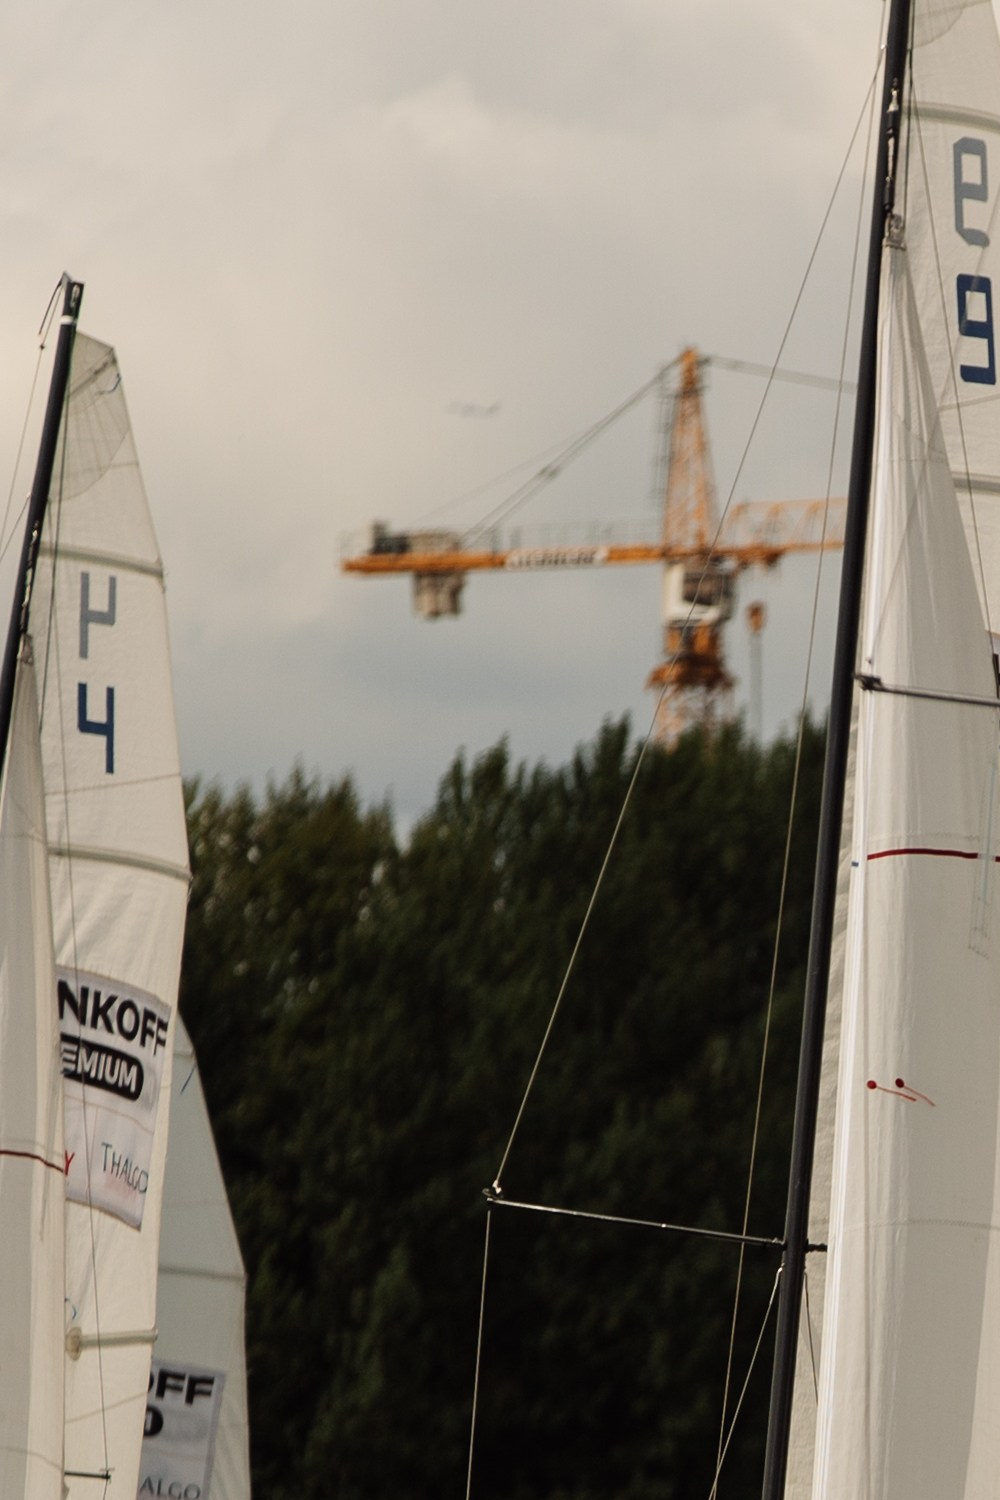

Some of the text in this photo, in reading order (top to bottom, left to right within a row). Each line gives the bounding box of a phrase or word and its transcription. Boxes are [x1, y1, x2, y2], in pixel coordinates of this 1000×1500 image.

[957, 274, 996, 385] 9
[78, 682, 115, 775] 4
[57, 980, 169, 1056] NKOFF
